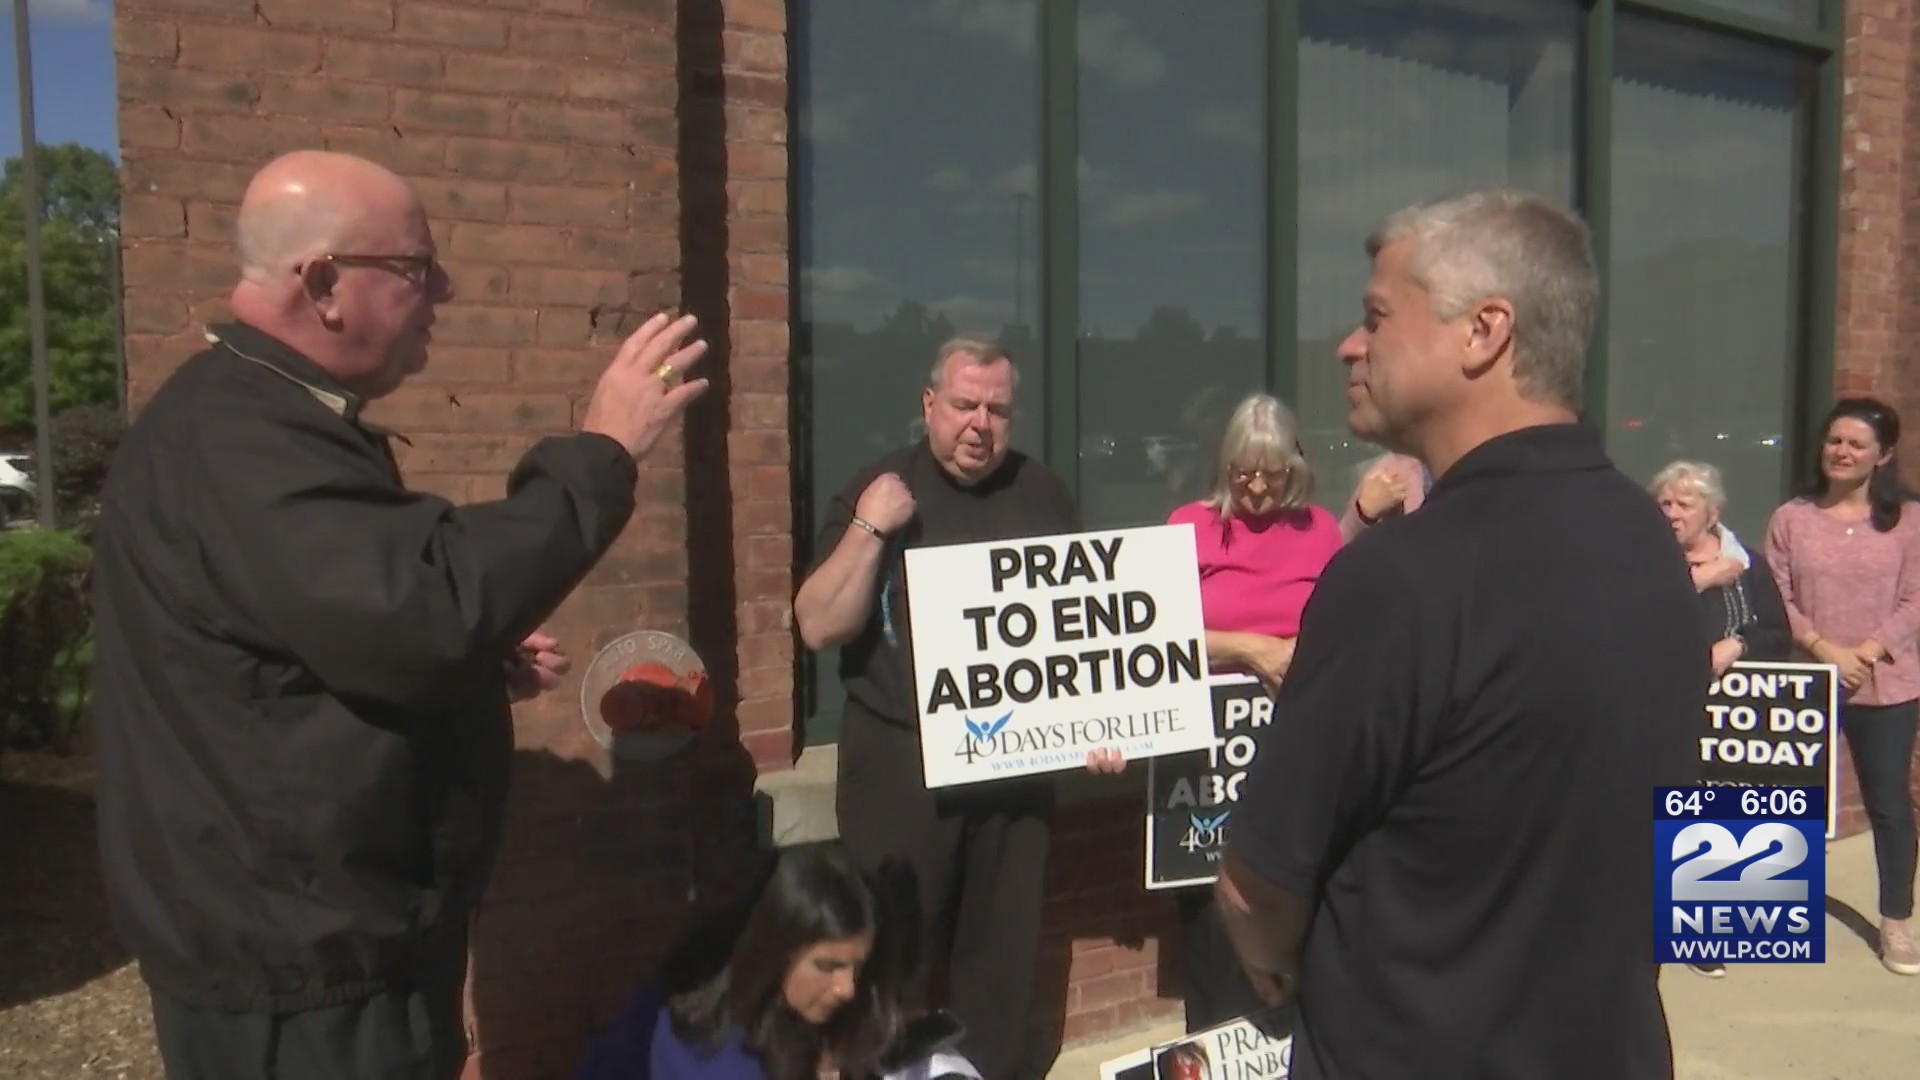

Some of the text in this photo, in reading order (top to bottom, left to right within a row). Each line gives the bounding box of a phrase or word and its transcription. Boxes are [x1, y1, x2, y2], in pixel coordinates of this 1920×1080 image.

[989, 536, 1124, 593] PRAY
[963, 590, 1157, 652] TO END
[926, 638, 1202, 715] ABORTION
[1070, 716, 1125, 745] FOR
[1126, 707, 1186, 737] LIFE
[1225, 696, 1274, 730] PR
[1705, 705, 1825, 735] TO DO
[1207, 735, 1256, 768] TO
[1699, 737, 1824, 767] TODAY
[1216, 1026, 1273, 1060] PRA
